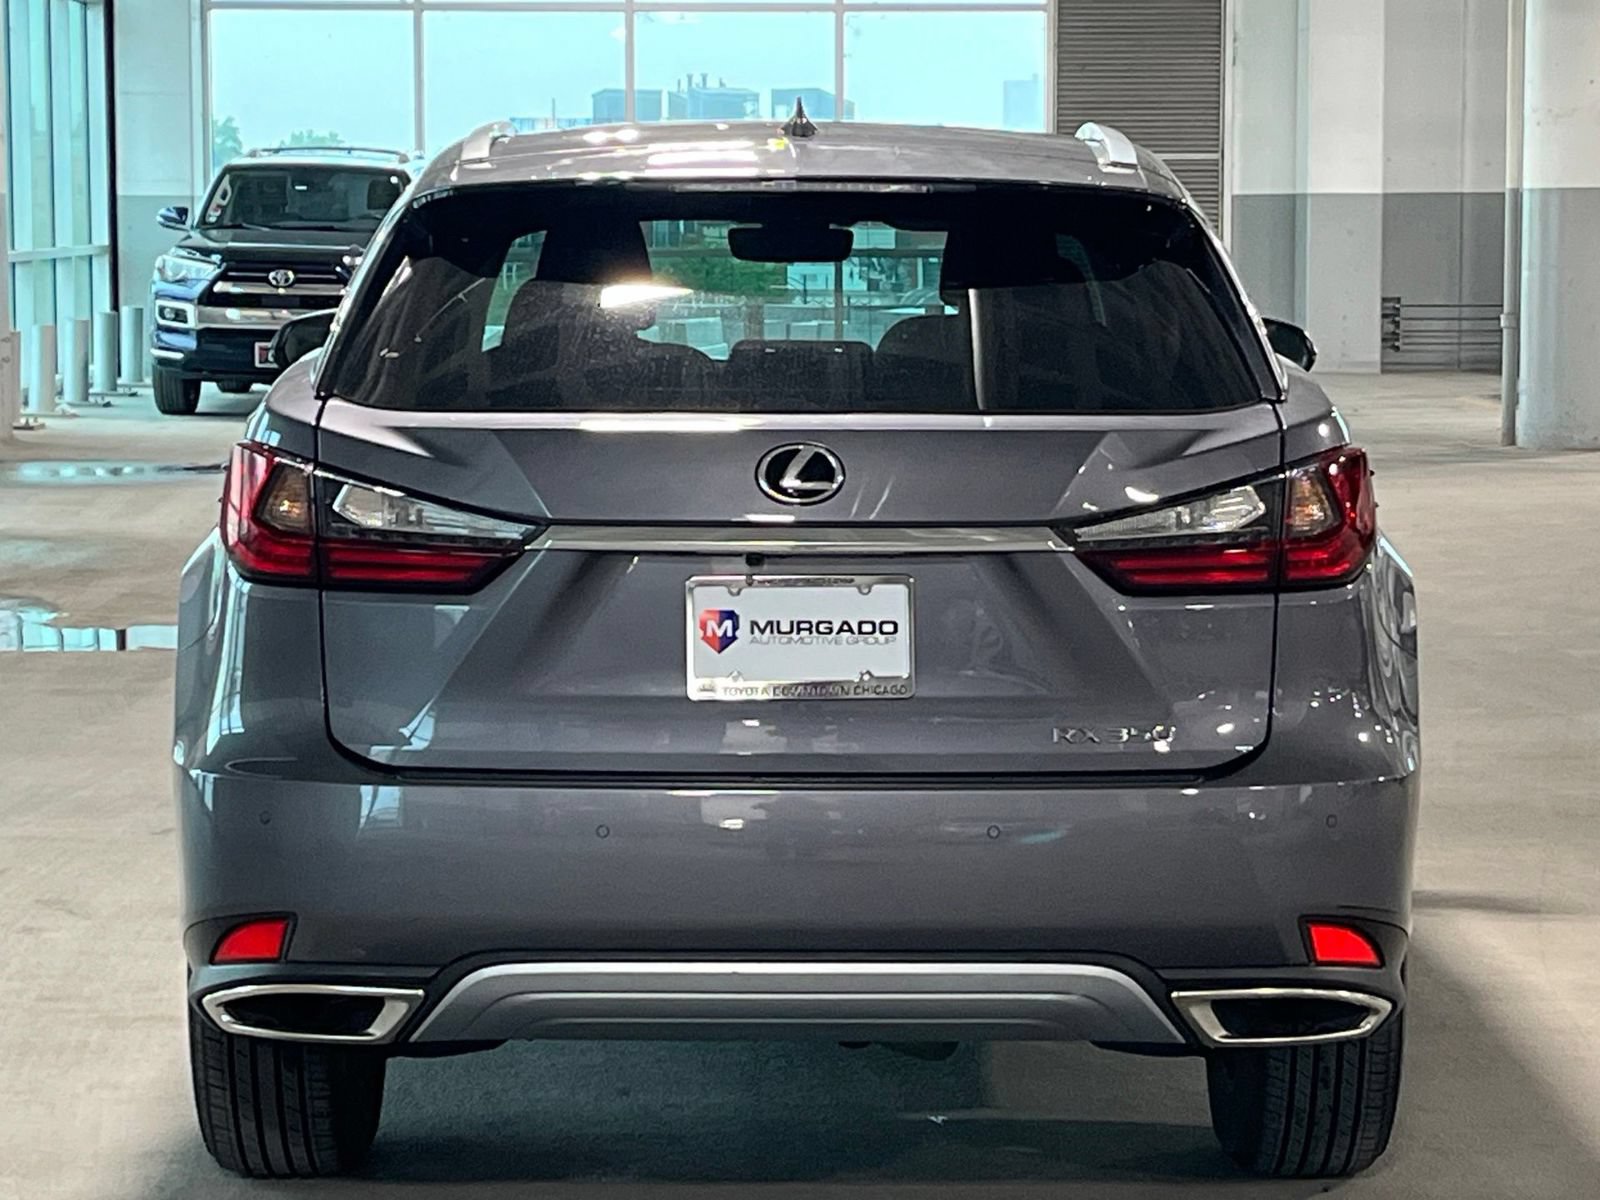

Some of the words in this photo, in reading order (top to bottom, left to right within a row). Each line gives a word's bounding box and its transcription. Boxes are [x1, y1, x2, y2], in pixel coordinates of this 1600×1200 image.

[749, 619, 899, 636] MURGADO
[749, 635, 843, 646] AUTOMOTIVE
[845, 635, 897, 646] GROUP
[721, 685, 769, 697] TOYOTA
[853, 683, 909, 696] CHICAGO
